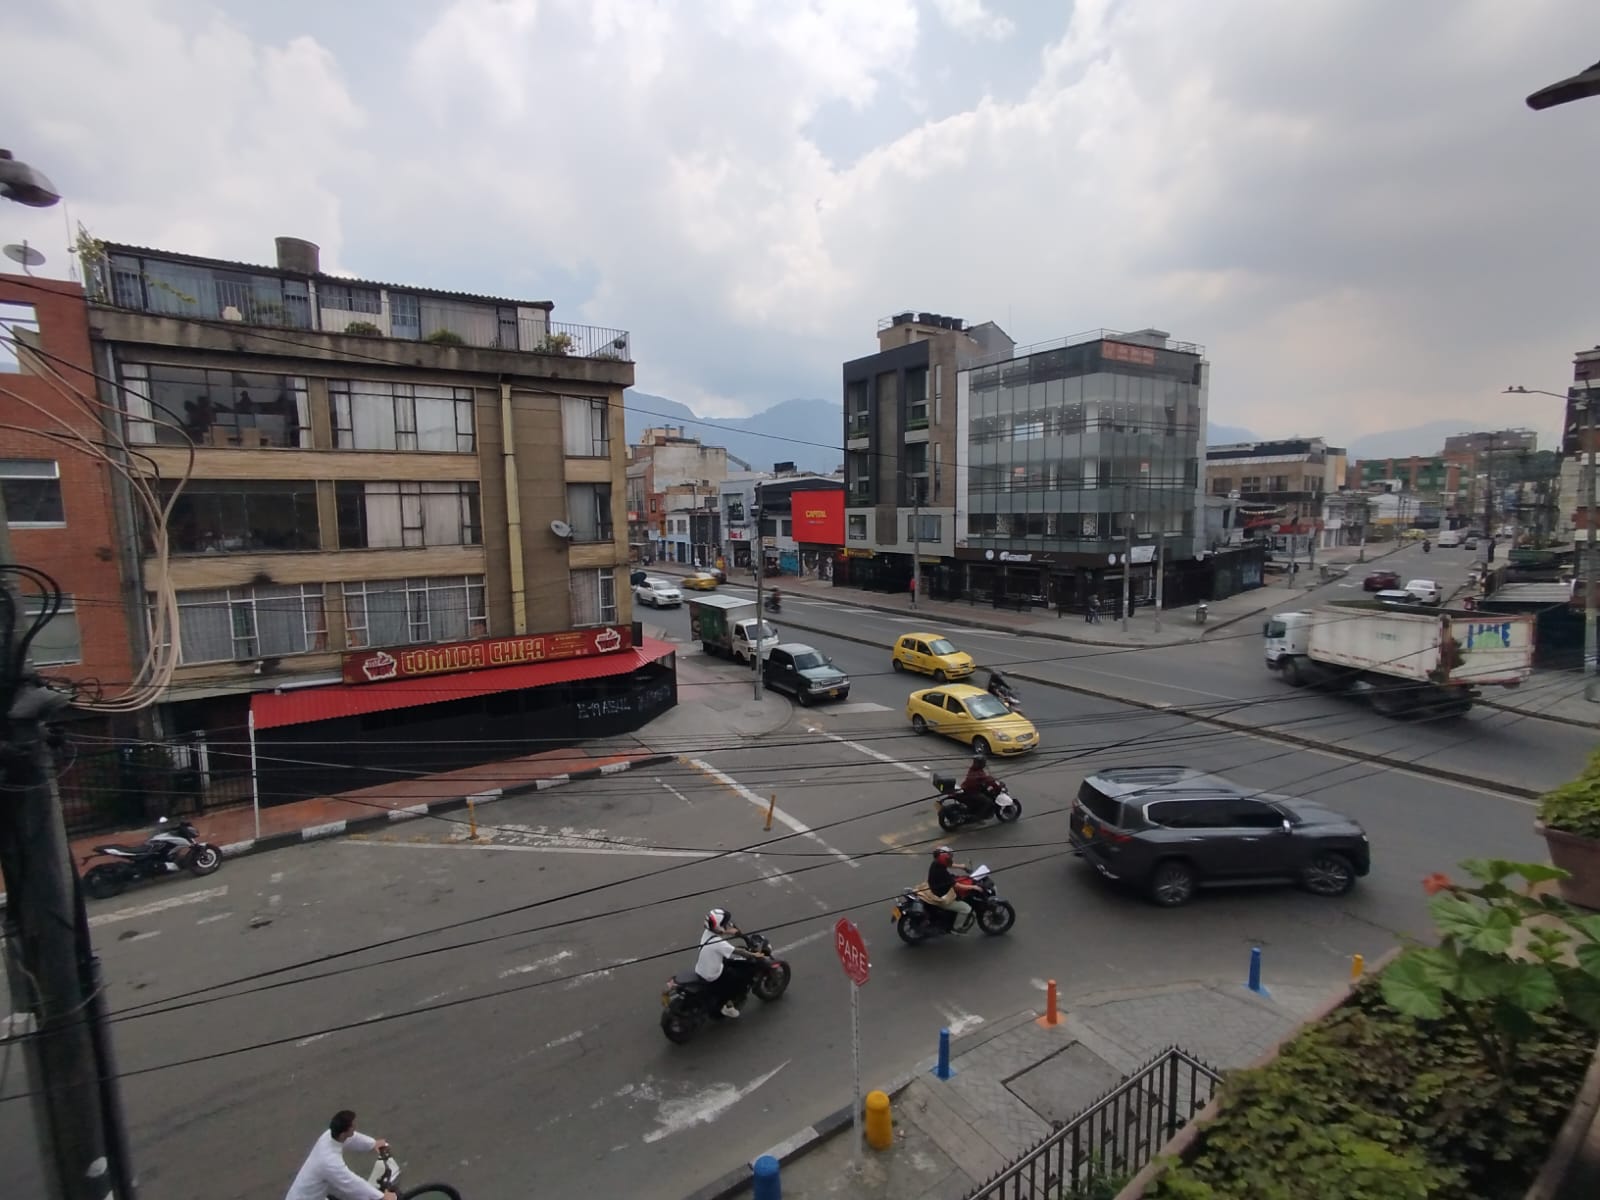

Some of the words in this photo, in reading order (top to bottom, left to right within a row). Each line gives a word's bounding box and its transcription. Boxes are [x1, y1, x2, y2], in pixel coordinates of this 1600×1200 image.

[401, 645, 485, 674] COMIDA
[489, 638, 545, 664] CHIFA
[838, 931, 867, 974] PARE
